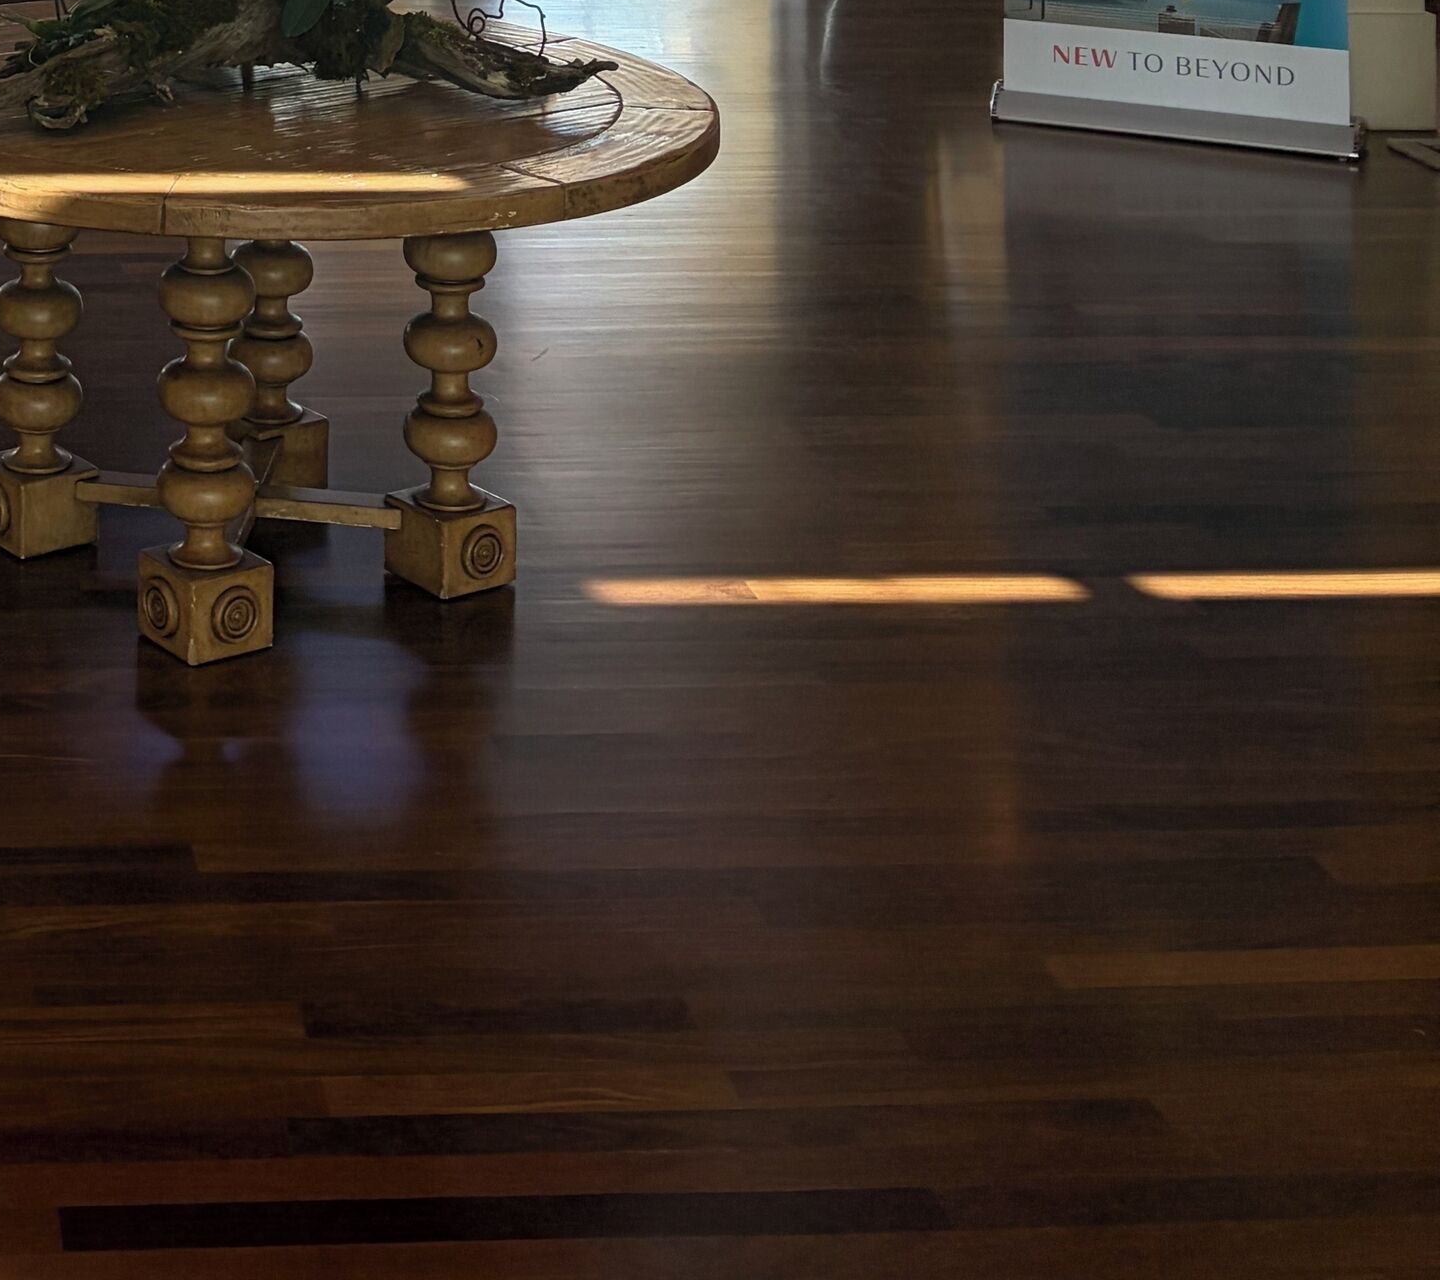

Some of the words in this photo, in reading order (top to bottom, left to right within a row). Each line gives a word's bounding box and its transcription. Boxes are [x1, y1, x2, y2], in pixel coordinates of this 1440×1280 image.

[1053, 45, 1117, 68] NEW
[1128, 51, 1163, 73] TO
[1176, 57, 1294, 86] BEYOND
